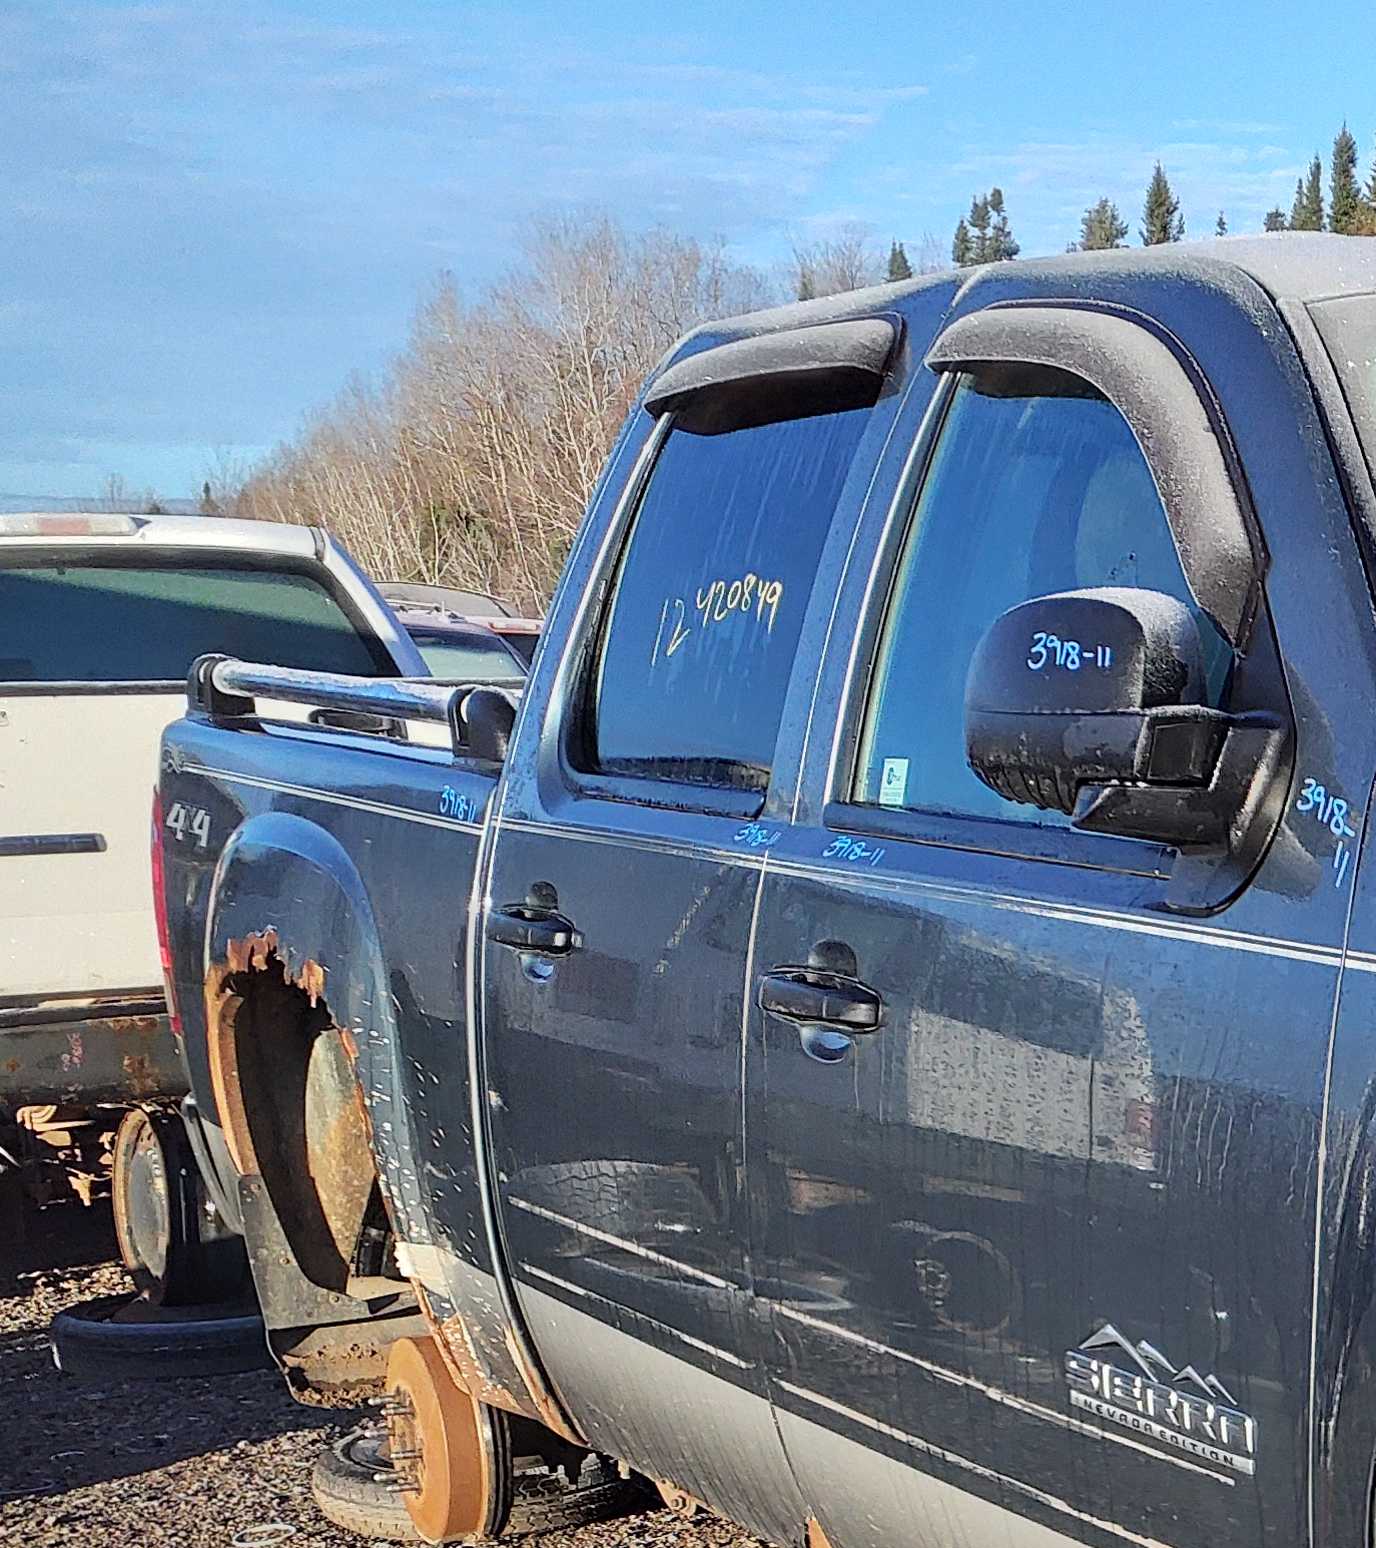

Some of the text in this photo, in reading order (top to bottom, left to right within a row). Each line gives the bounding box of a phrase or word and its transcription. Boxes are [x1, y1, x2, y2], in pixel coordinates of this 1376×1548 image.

[650, 572, 784, 670] 12420849
[1026, 631, 1112, 671] 3918-11
[1065, 1349, 1258, 1456] SIERRA
[1082, 1398, 1235, 1467] NEVADA EDITION
